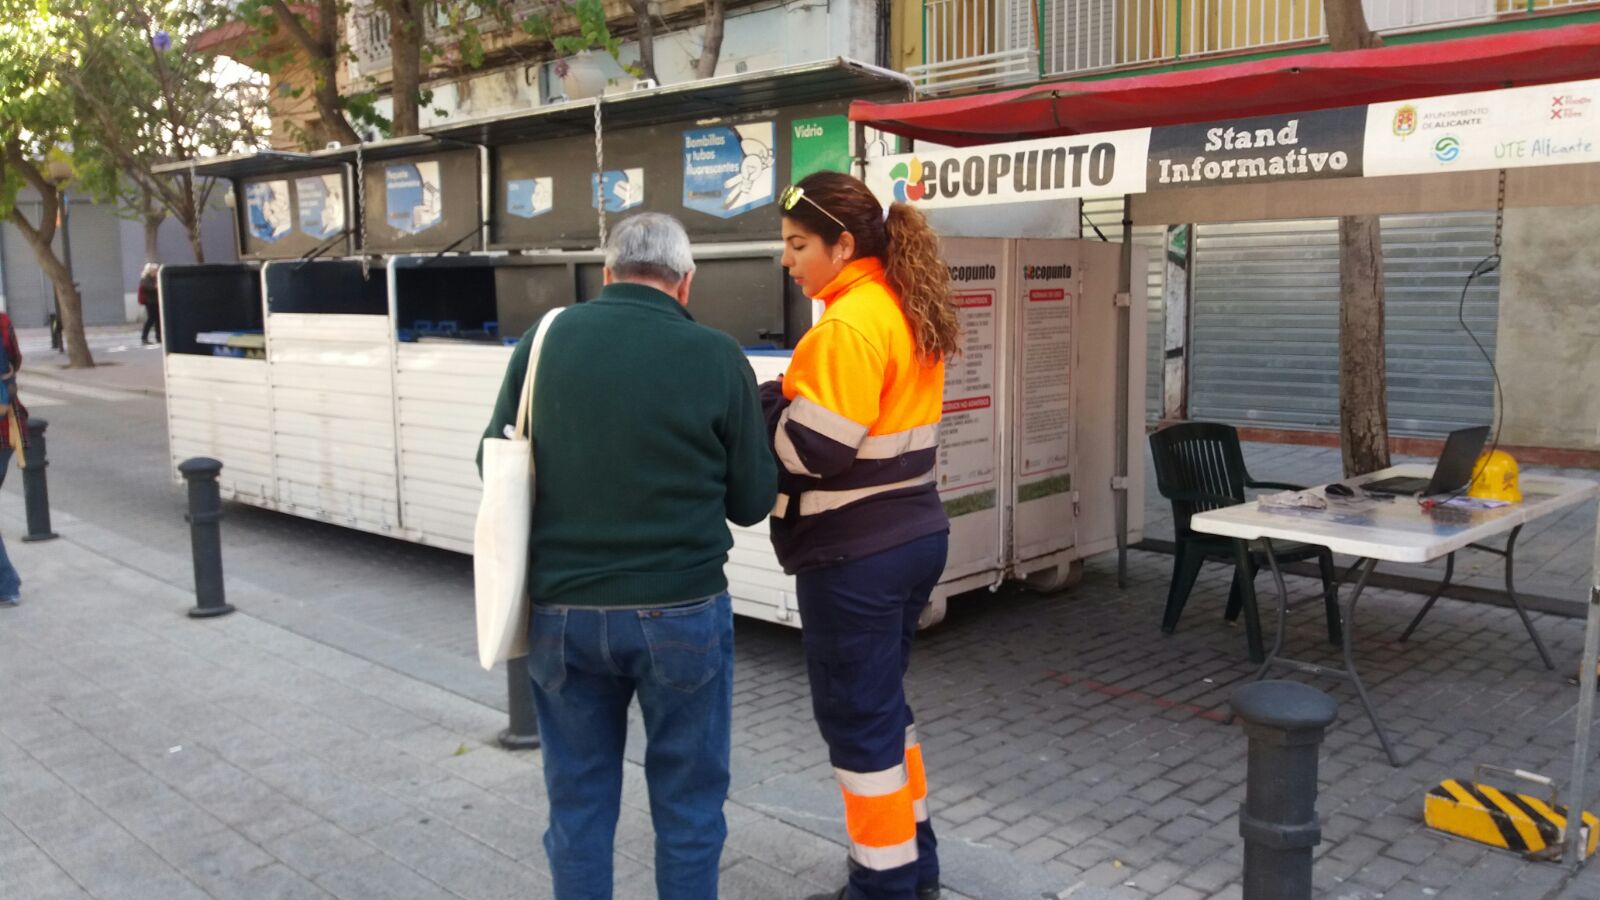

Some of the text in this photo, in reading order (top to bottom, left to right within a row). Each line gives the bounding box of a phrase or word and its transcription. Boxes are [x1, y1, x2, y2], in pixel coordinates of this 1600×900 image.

[1423, 108, 1488, 120] AYUNTAMIENTO
[1434, 118, 1482, 129] ALICANTE
[794, 125, 823, 138] Vidrio
[1205, 120, 1299, 151] Stand
[685, 134, 725, 149] Bombillas
[1494, 137, 1592, 159] UTE Alicante
[692, 149, 715, 161] tubos
[686, 161, 739, 175] fluorescentes
[1159, 147, 1348, 183] Informativo
